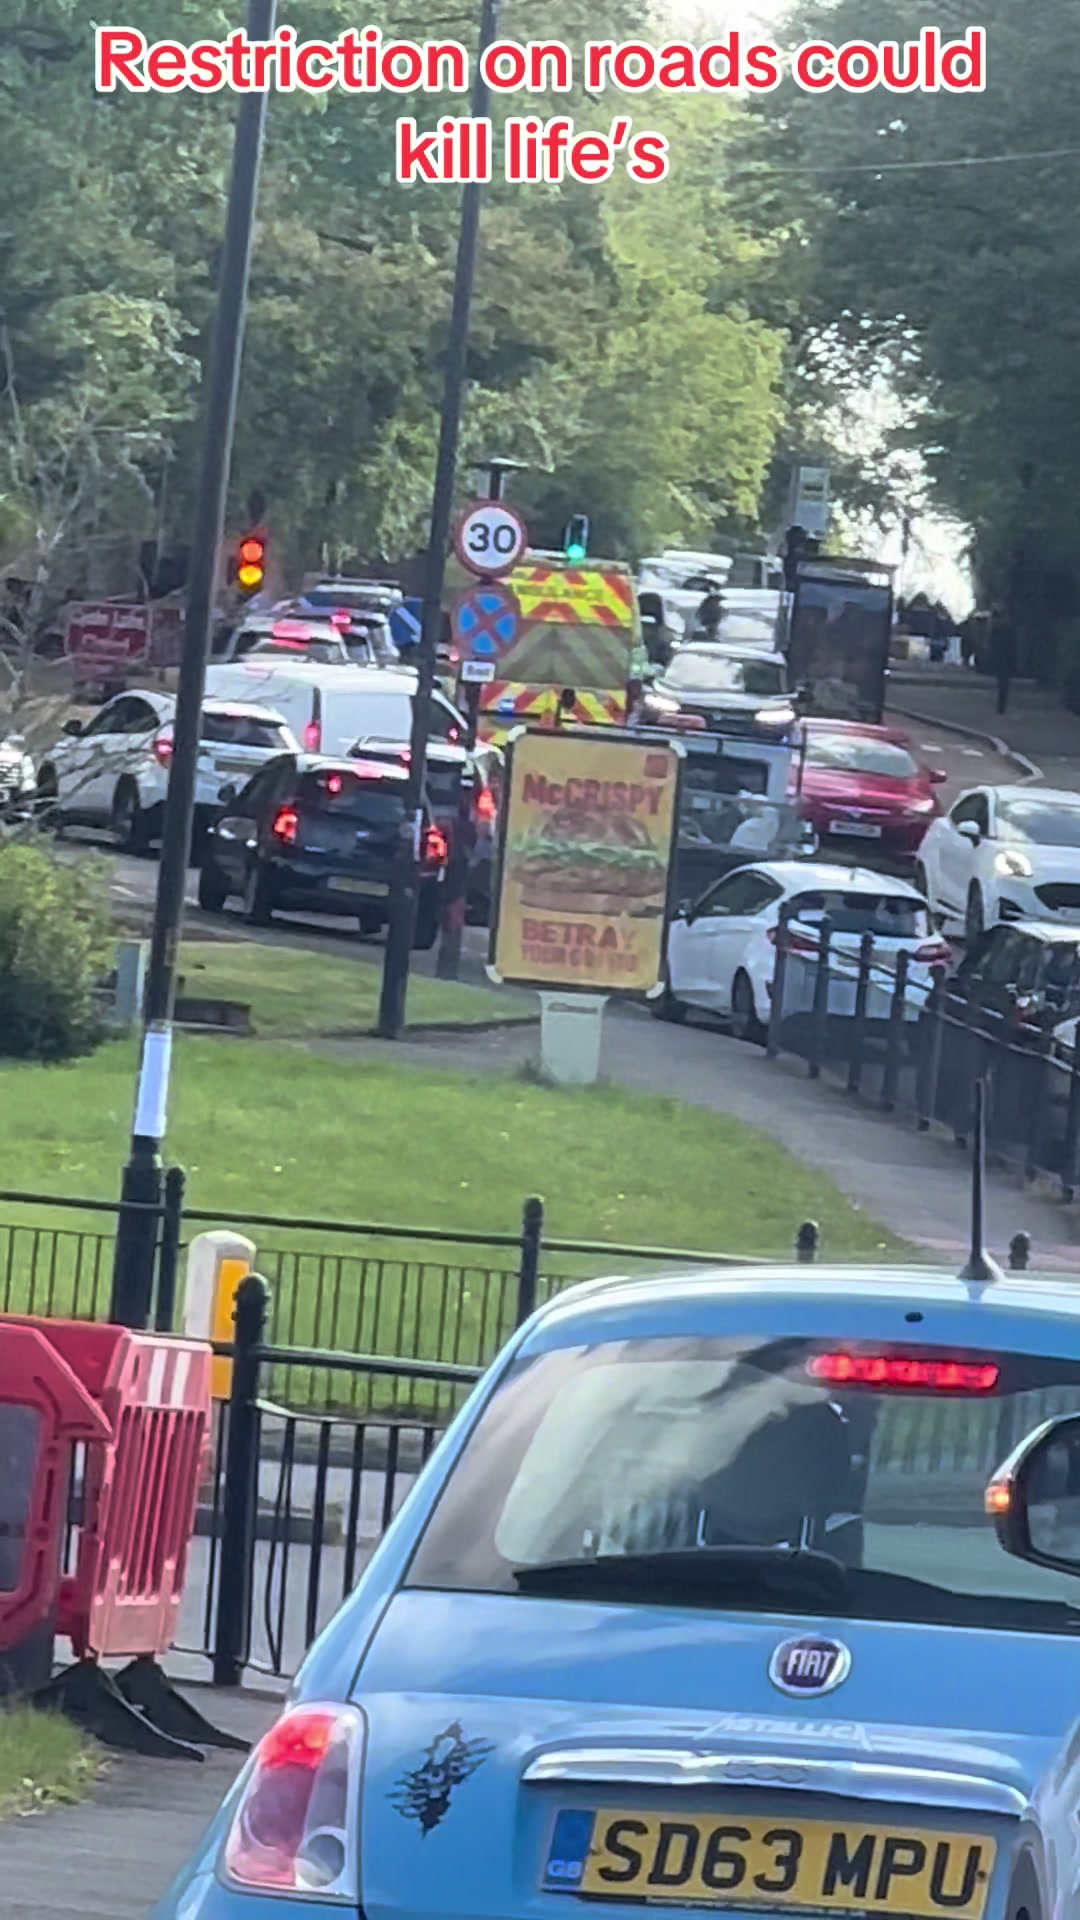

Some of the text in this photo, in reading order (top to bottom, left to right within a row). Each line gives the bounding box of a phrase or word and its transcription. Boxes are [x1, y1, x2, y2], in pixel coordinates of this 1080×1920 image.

[469, 523, 516, 553] 30
[787, 1650, 835, 1679] FIAT
[547, 1859, 582, 1878] GB
[598, 1820, 982, 1906] SD63 MPU
